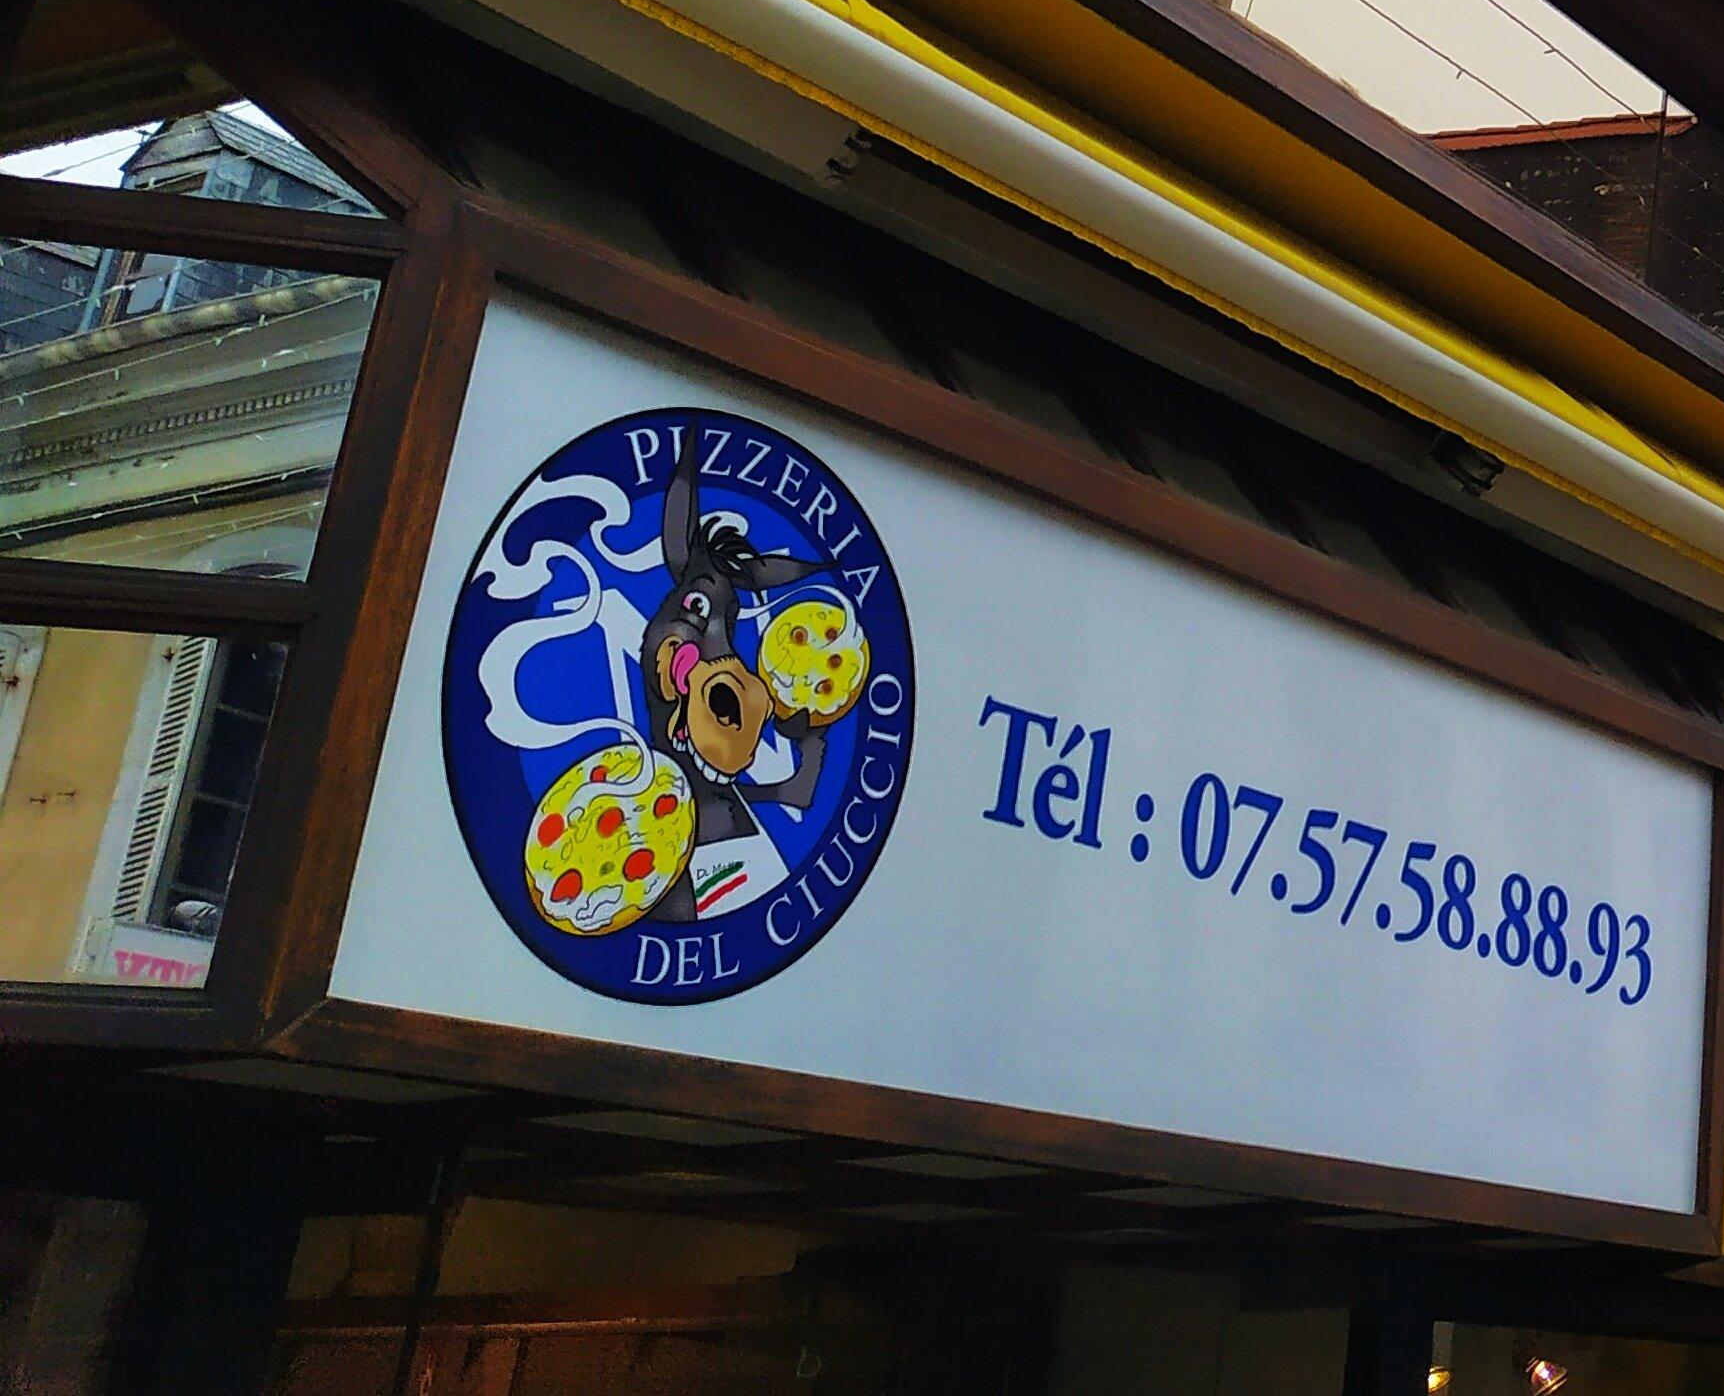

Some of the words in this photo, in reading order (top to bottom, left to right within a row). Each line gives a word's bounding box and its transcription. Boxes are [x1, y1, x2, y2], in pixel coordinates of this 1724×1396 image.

[624, 425, 885, 608] PIZZERIA
[629, 931, 741, 987] DEL
[765, 672, 903, 945] CIUCCIO
[1180, 771, 1653, 1007] 07.57.58.88.93
